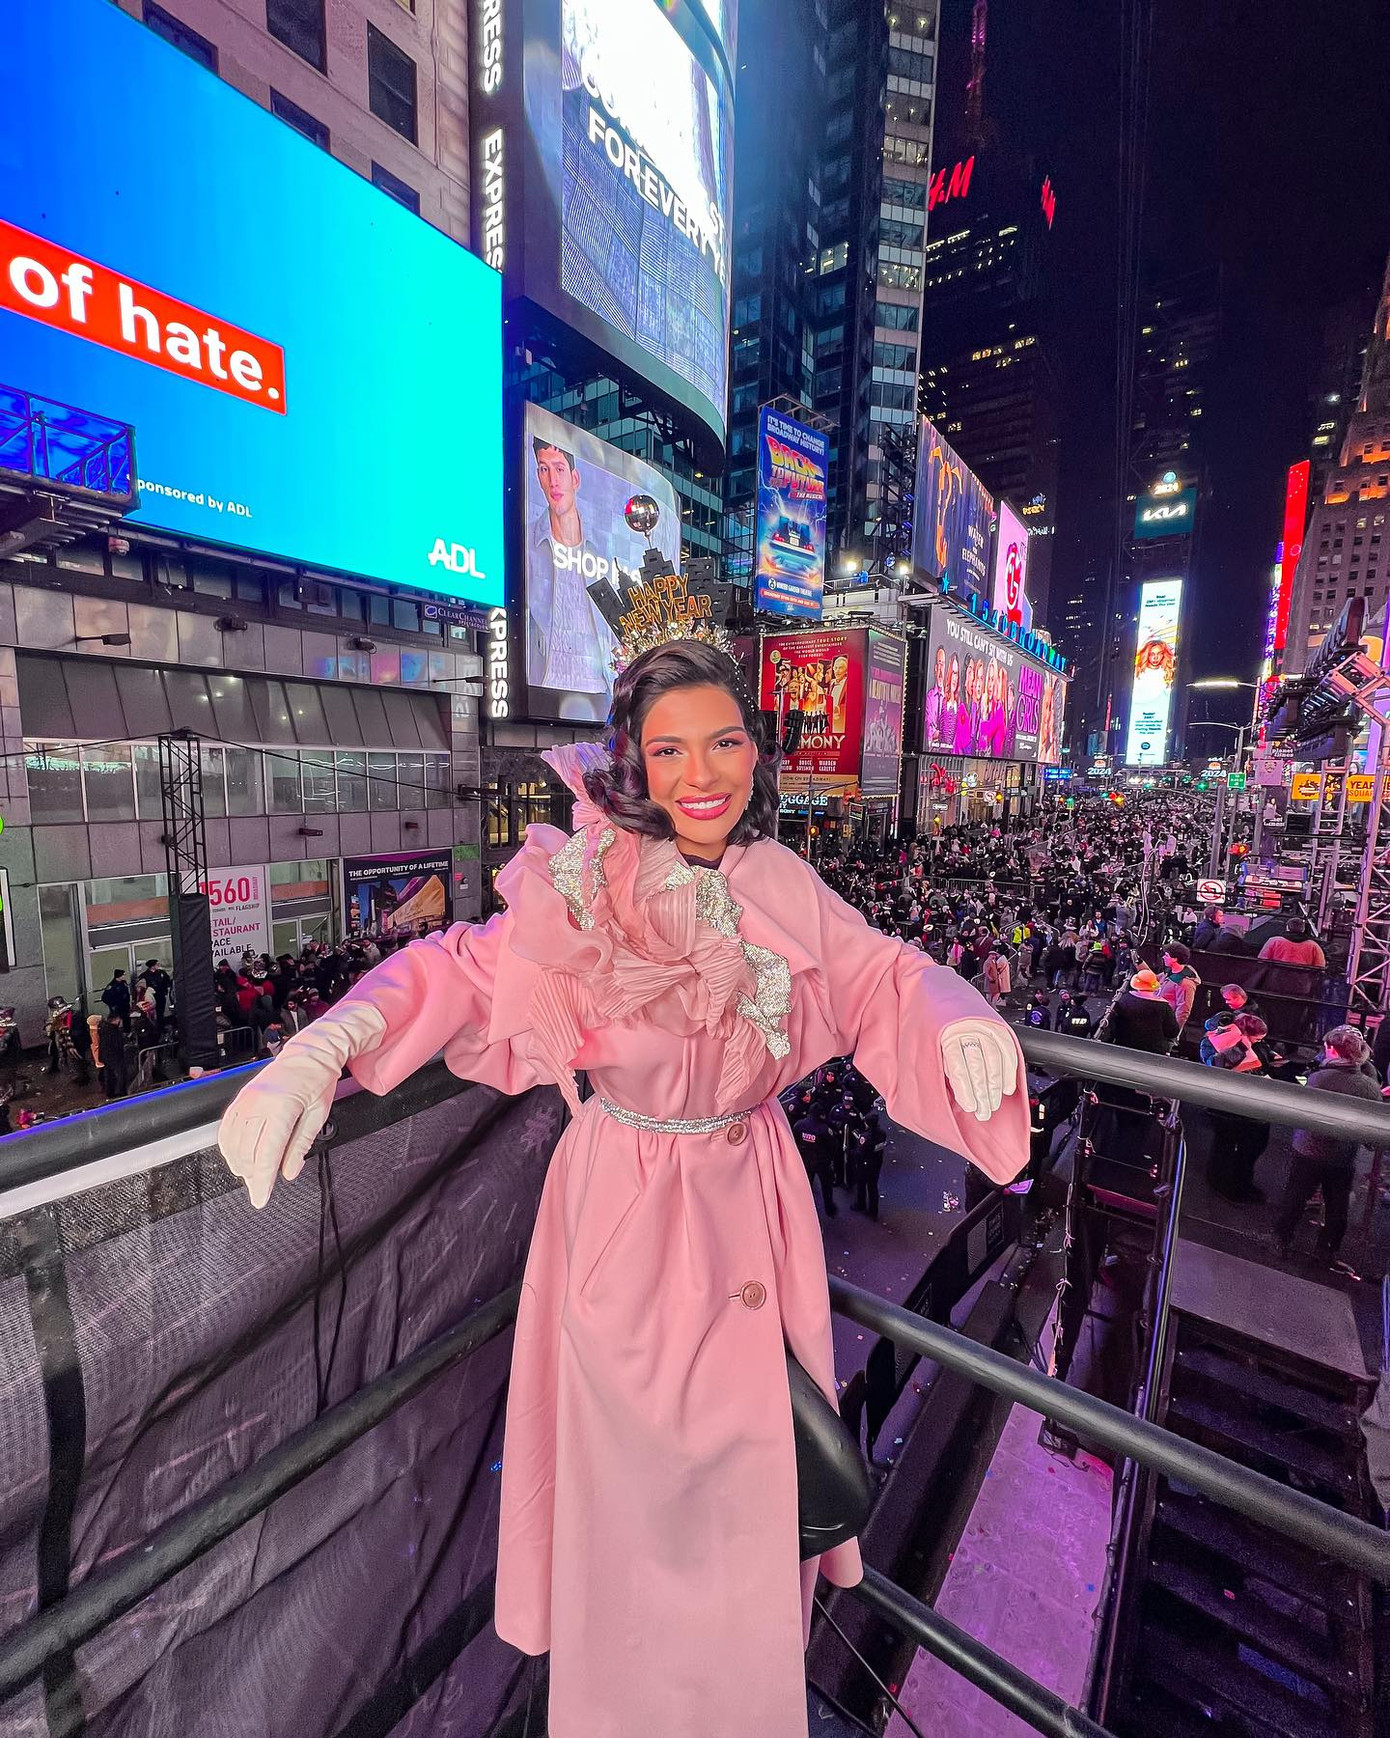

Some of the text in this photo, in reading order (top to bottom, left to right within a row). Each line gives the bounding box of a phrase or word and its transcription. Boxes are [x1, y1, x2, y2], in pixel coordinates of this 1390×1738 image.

[928, 156, 974, 211] H&M
[485, 129, 503, 273] EXPRES
[10, 257, 279, 399] of hate.
[768, 424, 799, 444] BROADWAY
[779, 420, 793, 433] TIME
[794, 427, 802, 437] TO
[802, 431, 824, 448] CHANGE
[765, 434, 824, 479] BACK
[127, 474, 252, 517] ponsored by ADL
[784, 469, 824, 493] FUTURE
[968, 524, 984, 549] WATER
[428, 538, 486, 579] ADL
[553, 543, 609, 581] SHOP
[961, 547, 986, 578] ELEPHANTS
[627, 573, 689, 608] HAPPY
[619, 594, 712, 636] NEW YEAR
[947, 619, 960, 639] YOU
[960, 627, 974, 647] STILL
[989, 643, 997, 658] SIT
[996, 647, 1007, 664] WITH
[1007, 653, 1013, 667] US
[970, 592, 1066, 672] 1540 BROADWAY
[1019, 664, 1042, 700] MEAN
[1016, 694, 1039, 734] GIRLS
[797, 735, 846, 749] MONY
[1087, 767, 1111, 775] 2024
[1201, 770, 1227, 778] 2024
[780, 794, 828, 806] UGGAGE
[363, 865, 409, 876] OPPORTUNITY
[423, 861, 449, 869] LIFETIME
[213, 917, 236, 928] TAIL/
[236, 903, 260, 911] FLAGSHIP
[213, 922, 260, 938] STAURANT
